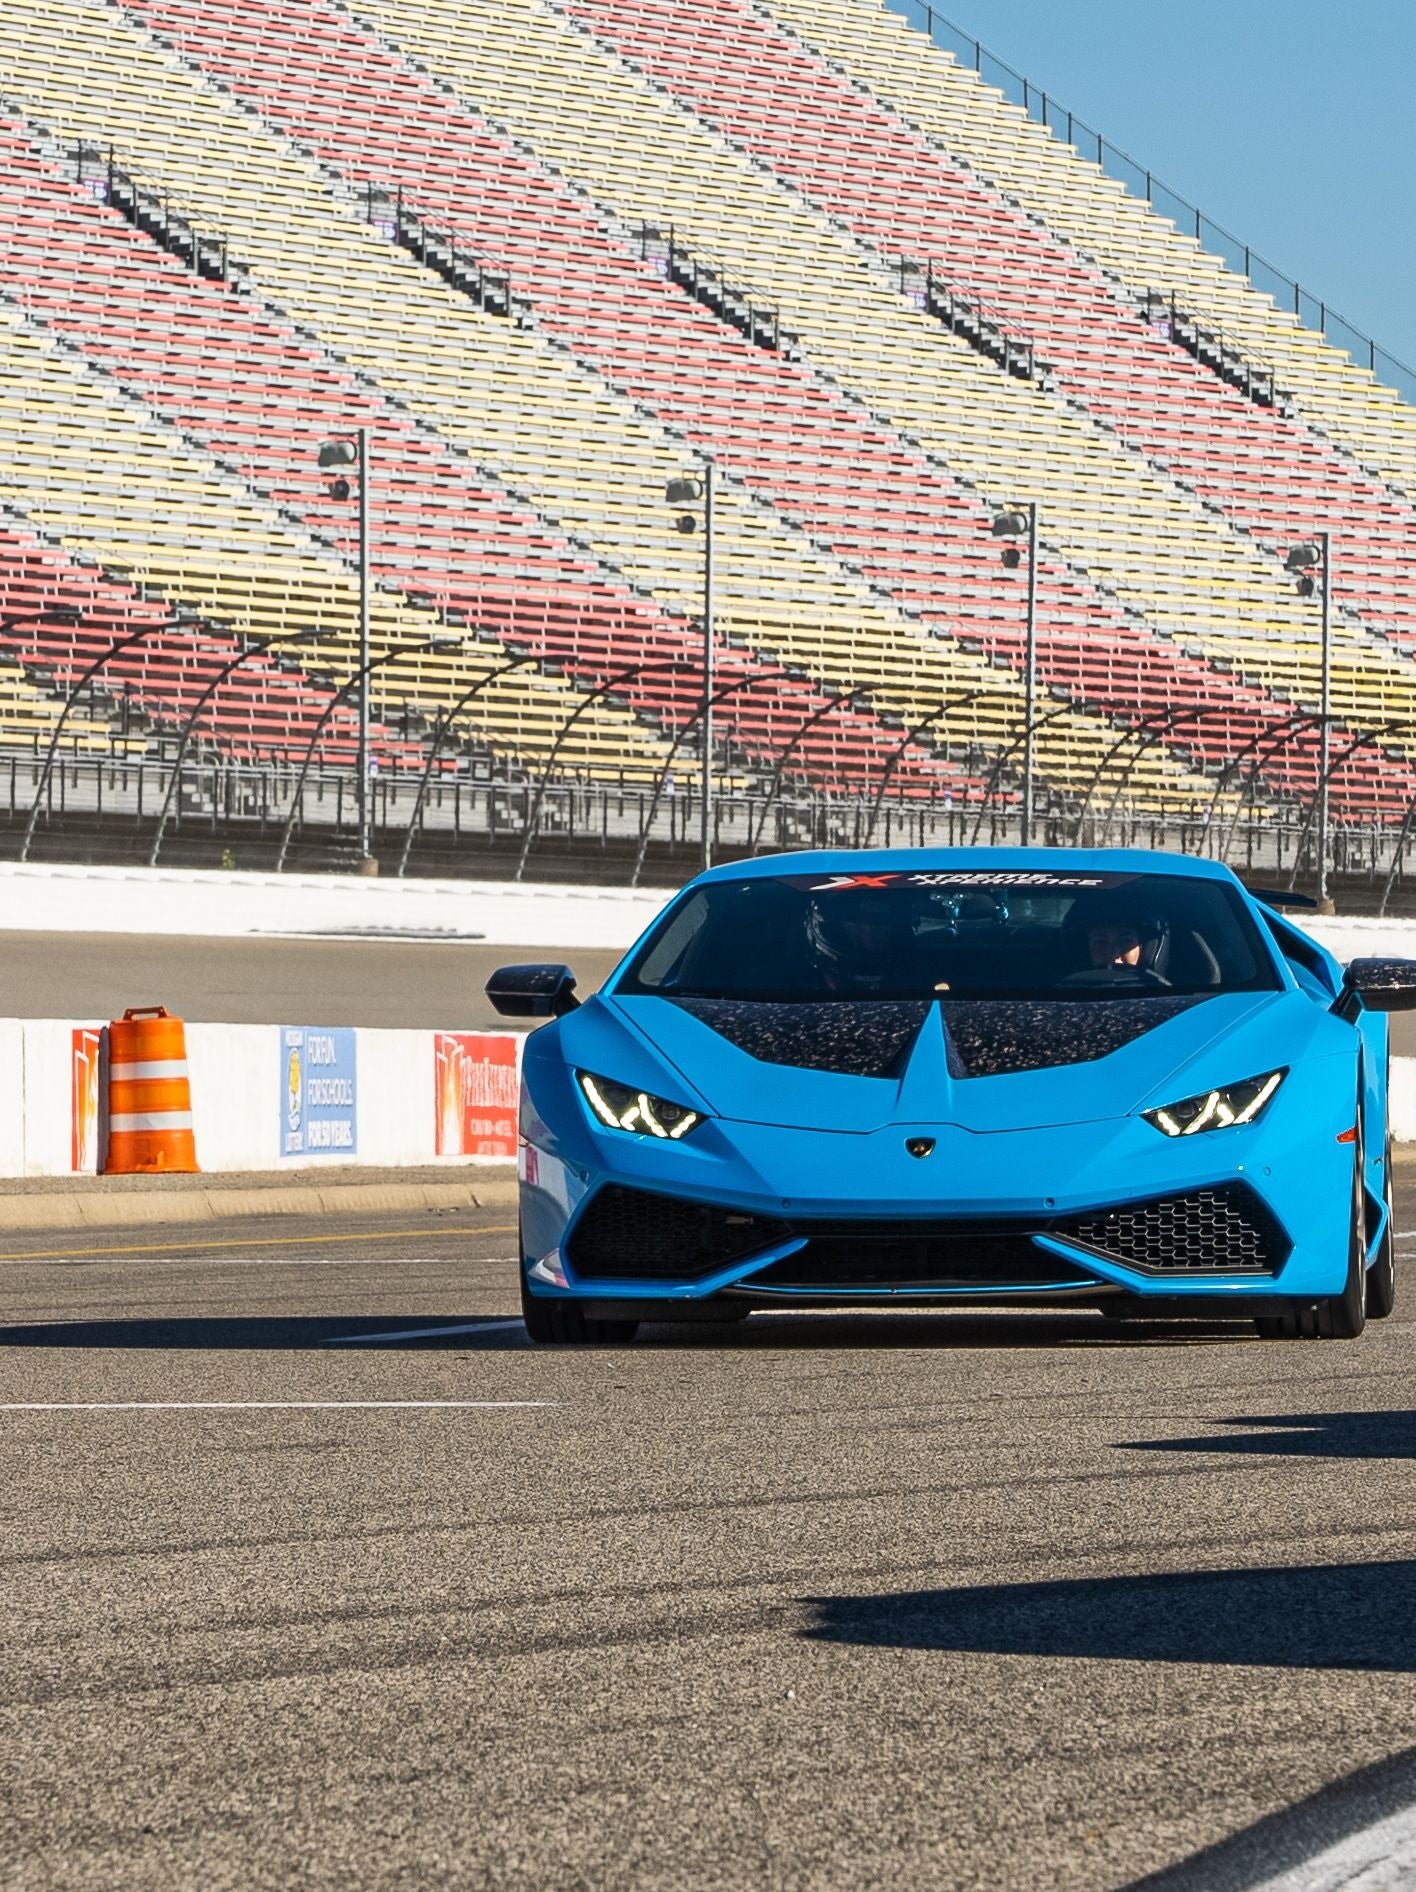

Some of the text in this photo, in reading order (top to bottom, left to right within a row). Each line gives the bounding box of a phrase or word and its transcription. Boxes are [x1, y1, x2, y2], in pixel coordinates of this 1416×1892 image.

[308, 1036, 321, 1064] FOR
[308, 1079, 322, 1105] FOR
[308, 1121, 321, 1147] FOR
